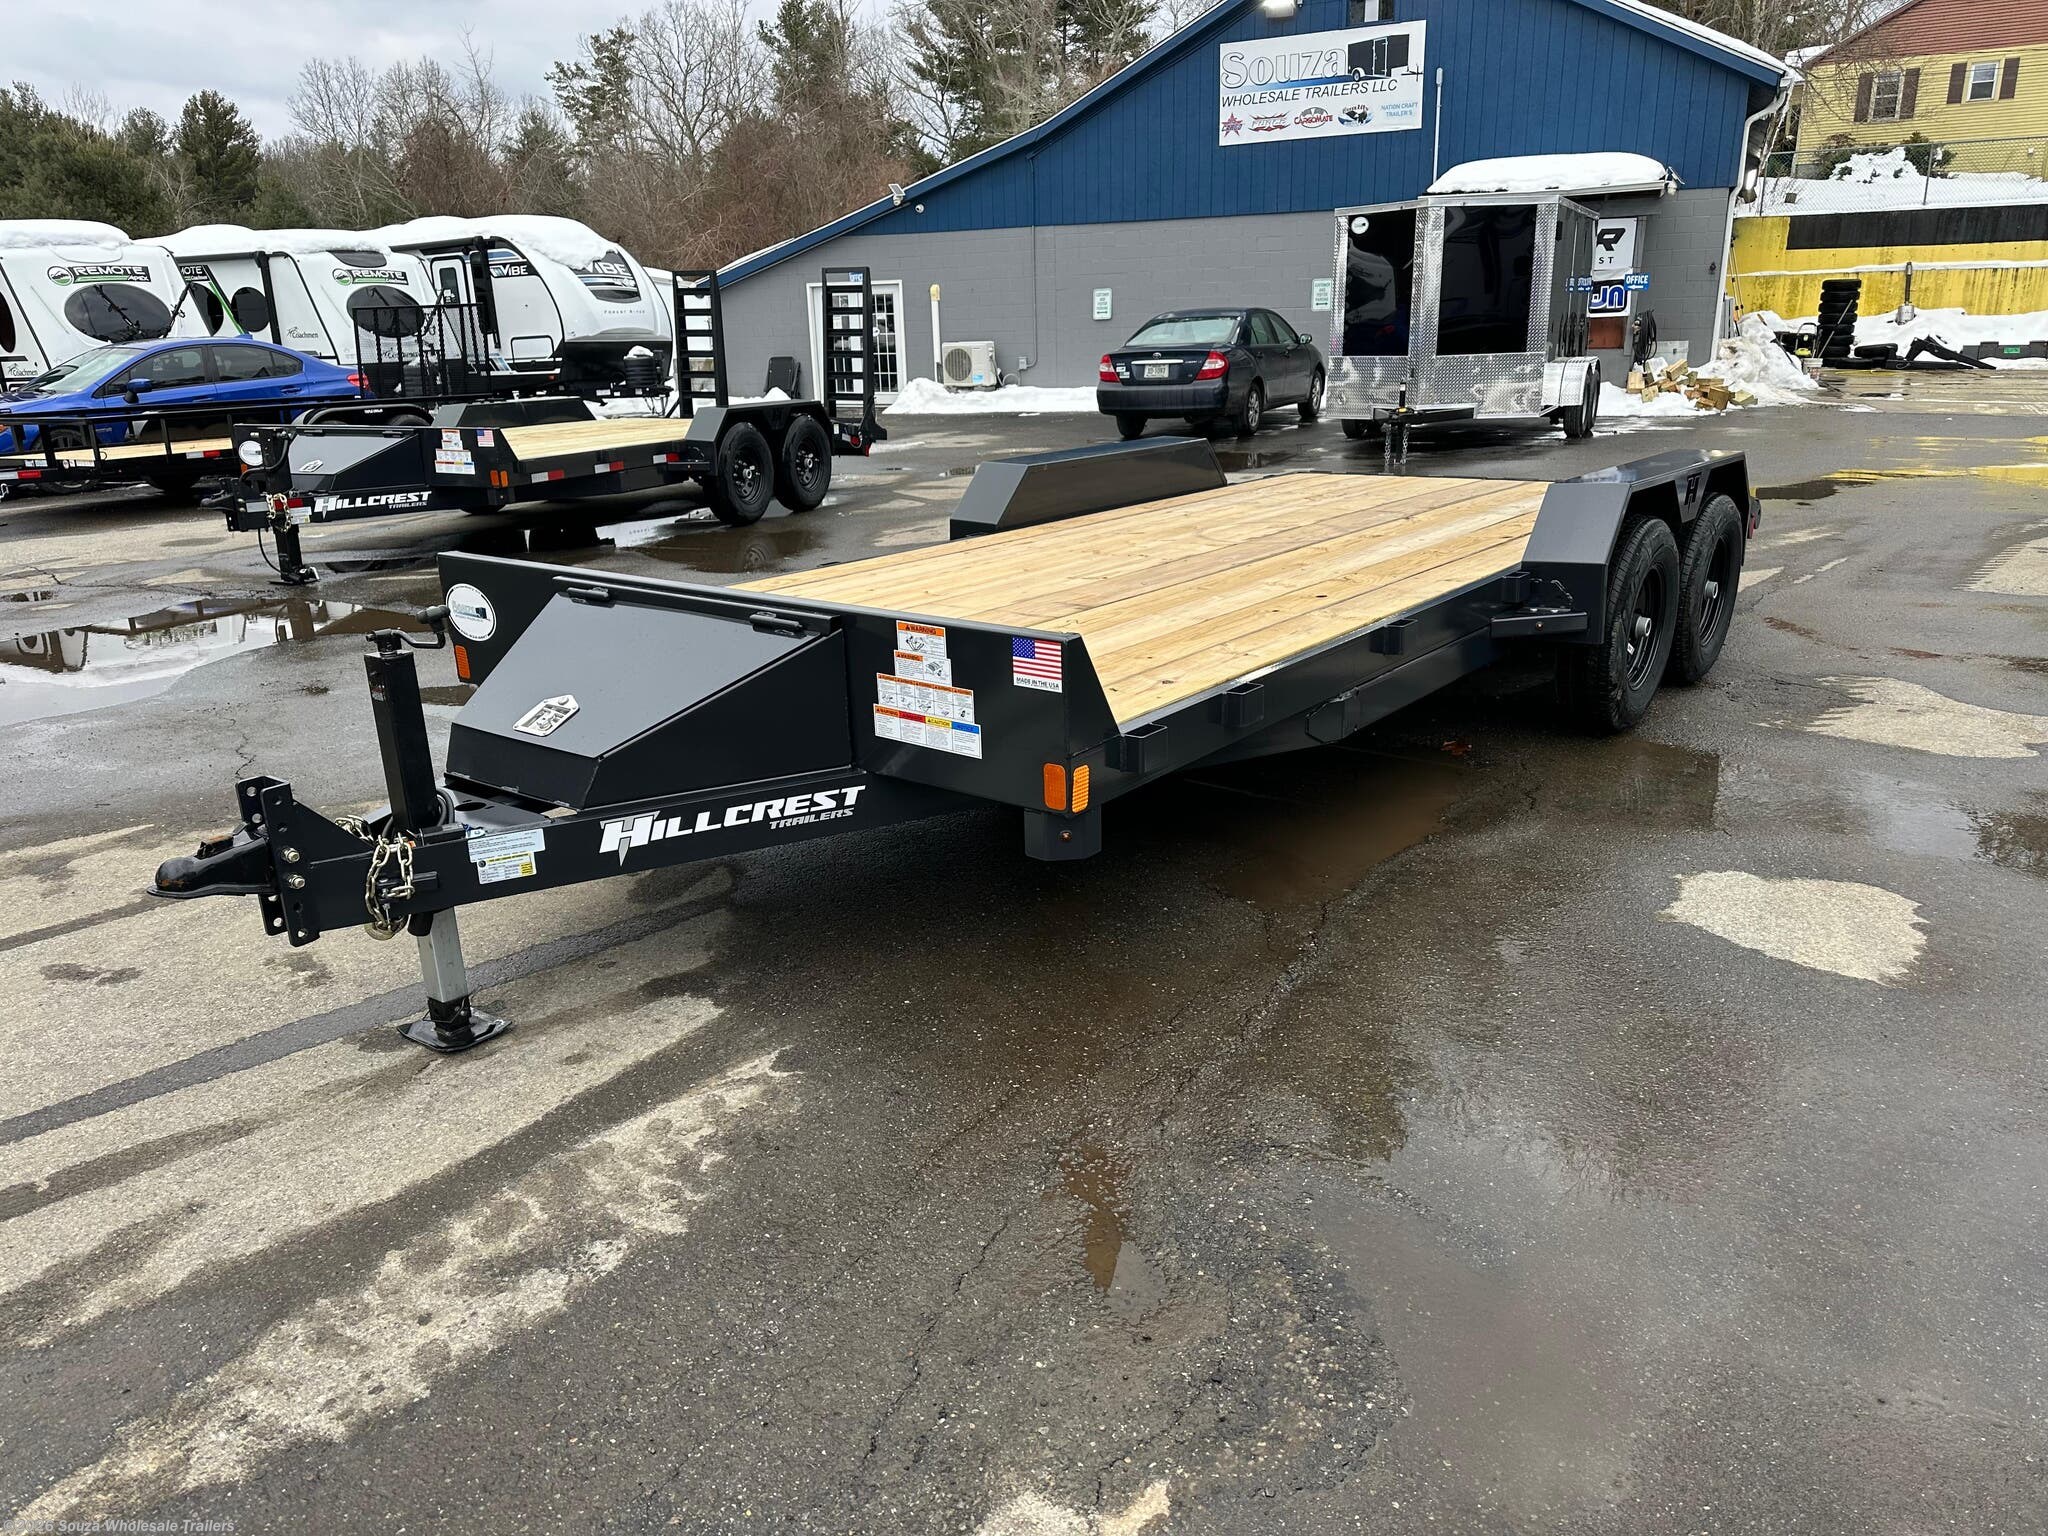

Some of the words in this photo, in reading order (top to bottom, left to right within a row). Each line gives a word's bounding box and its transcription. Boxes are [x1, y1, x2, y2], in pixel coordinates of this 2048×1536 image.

[1221, 48, 1347, 89] Souza
[1221, 88, 1300, 108] WHOLESALE
[1305, 81, 1369, 99] TRAILERS
[1372, 79, 1398, 93] LLC
[73, 266, 146, 276] REMOTE
[352, 269, 404, 279] REMOTE
[499, 264, 528, 276] VIBE
[1626, 275, 1649, 285] OFFICE
[313, 490, 432, 516] HILLCREST
[388, 501, 428, 509] TRAILERS
[910, 625, 936, 635] WARNING
[1016, 677, 1031, 685] MADE
[599, 784, 866, 864] HILLCREST
[769, 807, 855, 830] TRAILERS
